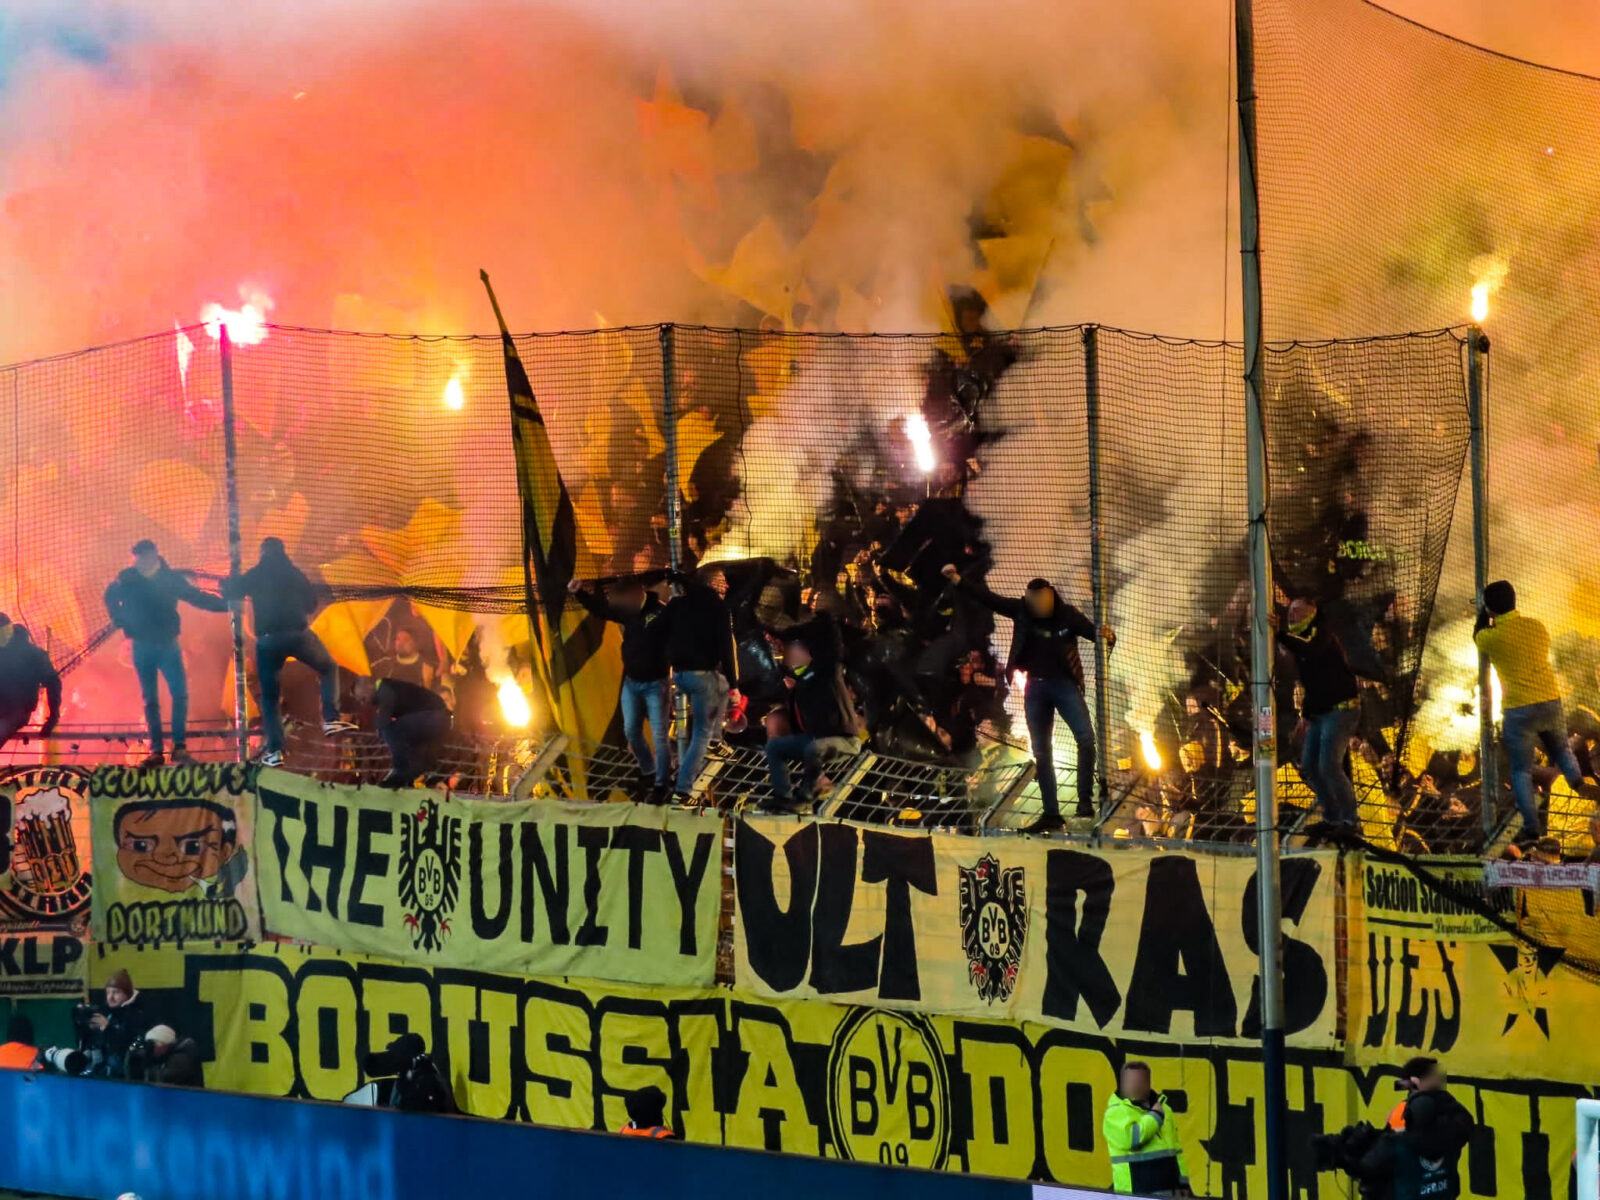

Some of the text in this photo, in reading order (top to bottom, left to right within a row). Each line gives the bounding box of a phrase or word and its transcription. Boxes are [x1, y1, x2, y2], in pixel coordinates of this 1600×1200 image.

[107, 898, 248, 944] DORTMUND
[259, 785, 715, 957] THE UNITY
[849, 1024, 936, 1141] BVB
